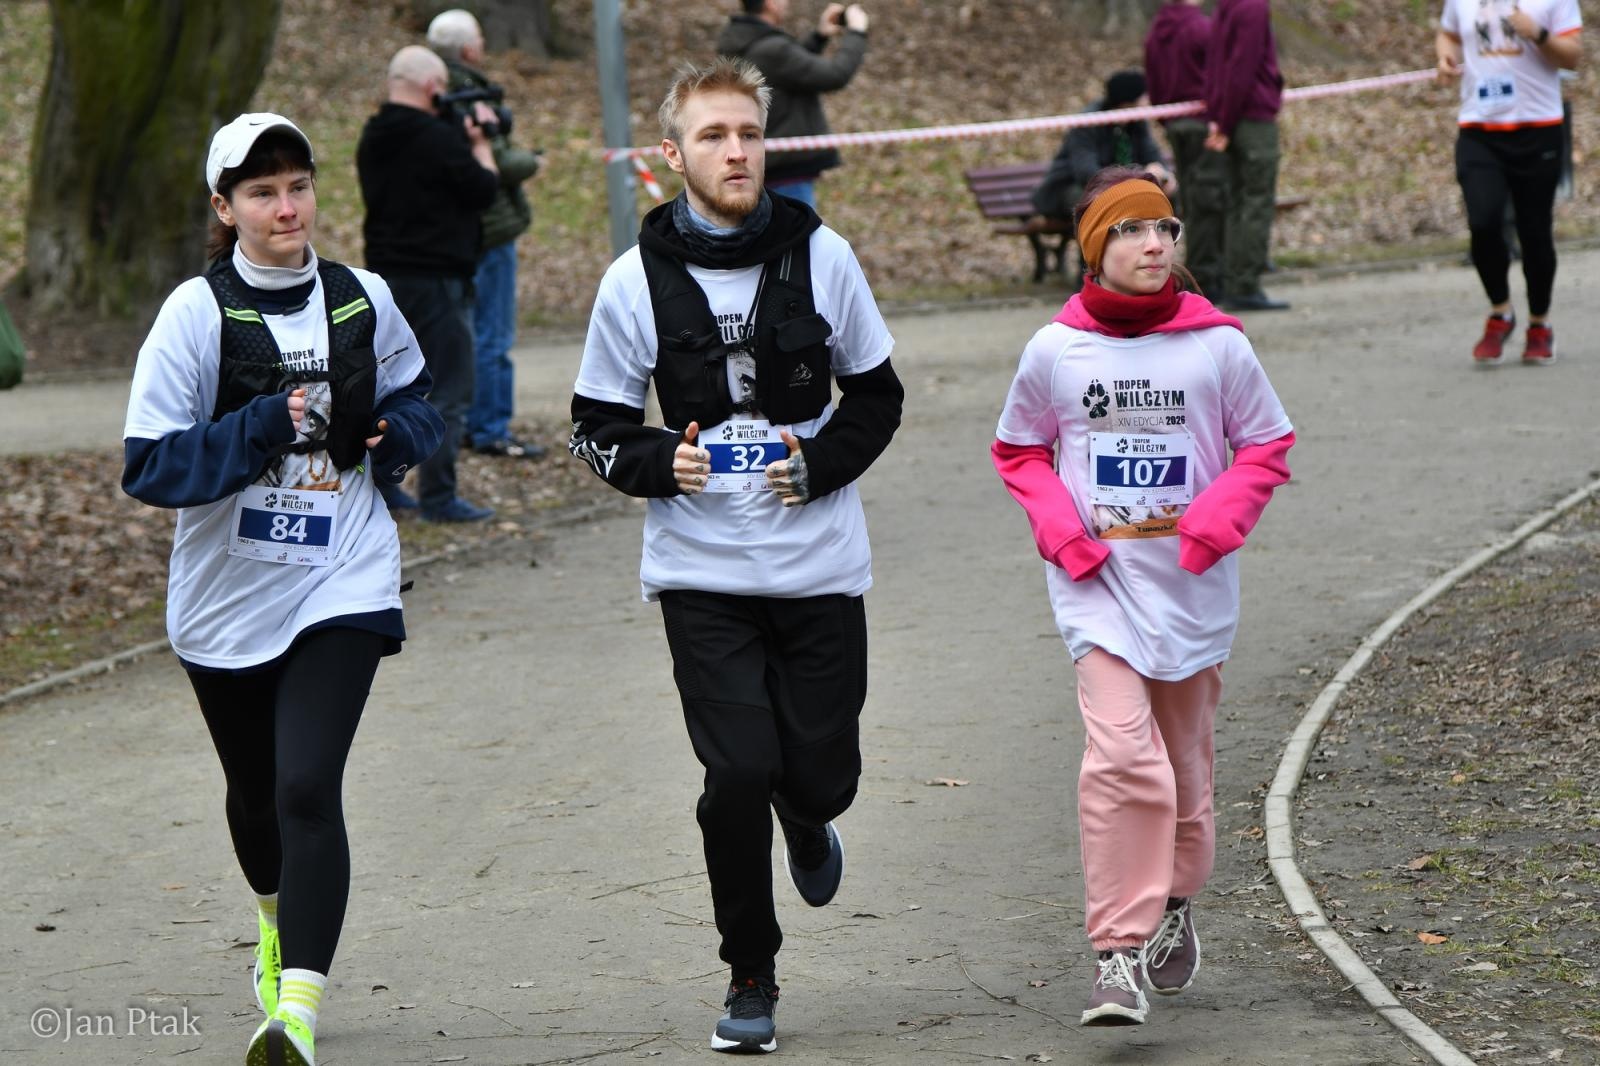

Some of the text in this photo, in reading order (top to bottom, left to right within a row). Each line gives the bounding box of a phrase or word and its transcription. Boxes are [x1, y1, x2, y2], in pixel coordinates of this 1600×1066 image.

[282, 348, 315, 362] TROPEM
[1113, 379, 1151, 390] TROPEM
[1115, 390, 1185, 408] WILCZYM
[1118, 415, 1186, 427] XIV EDYCJA 2026
[737, 430, 768, 439] WILCZYM
[1132, 444, 1167, 453] WILCZYM
[730, 444, 767, 472] 32
[1117, 459, 1172, 486] 107
[281, 500, 315, 511] WILCZYM
[269, 514, 308, 543] 84
